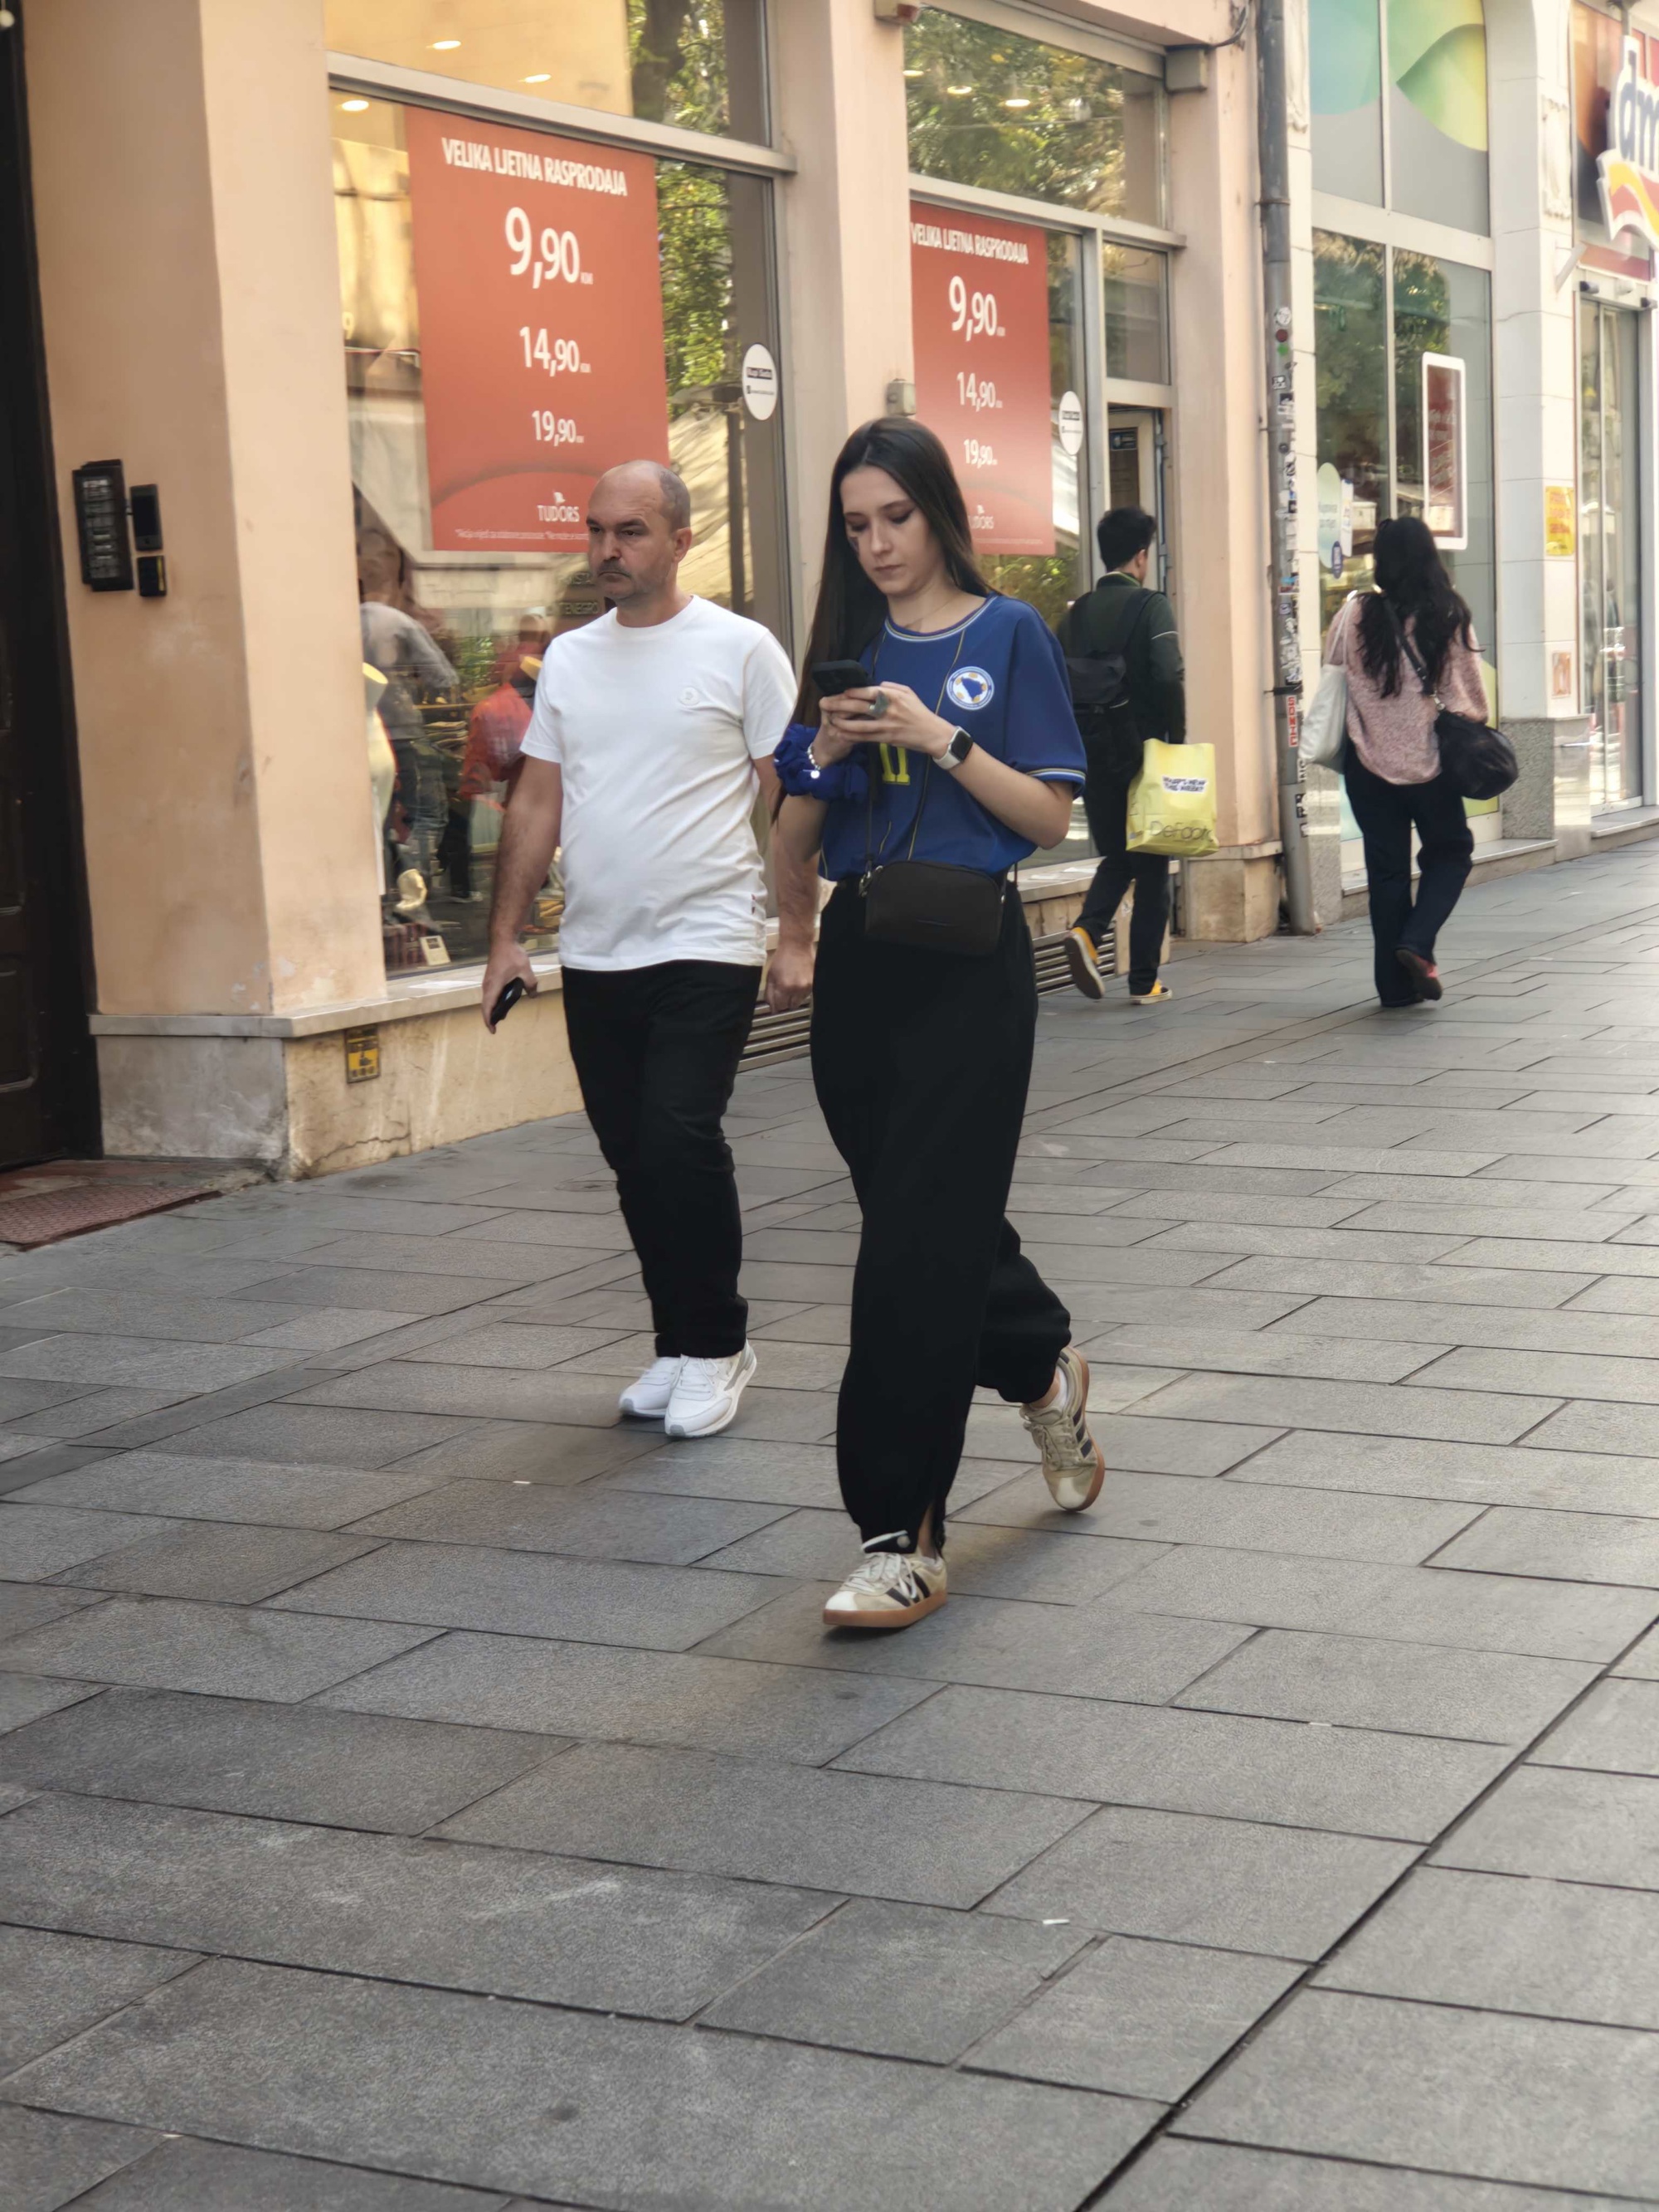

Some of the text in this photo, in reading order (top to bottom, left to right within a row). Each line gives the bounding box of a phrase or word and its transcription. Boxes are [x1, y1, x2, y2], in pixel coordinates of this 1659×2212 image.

[1620, 51, 1659, 171] dm
[441, 137, 628, 196] VELIKA LJETNA RASPRODAJA
[504, 207, 580, 289] 9,90
[911, 222, 1029, 265] VELIKA LJETNA RASPRODAJA
[949, 275, 997, 342] 9,90
[519, 326, 580, 377] 14,90
[957, 372, 995, 412] 14,90
[532, 410, 577, 446] 19,90
[964, 439, 994, 469] 19,90
[537, 504, 580, 522] TUDORS
[967, 515, 995, 529] UDORS
